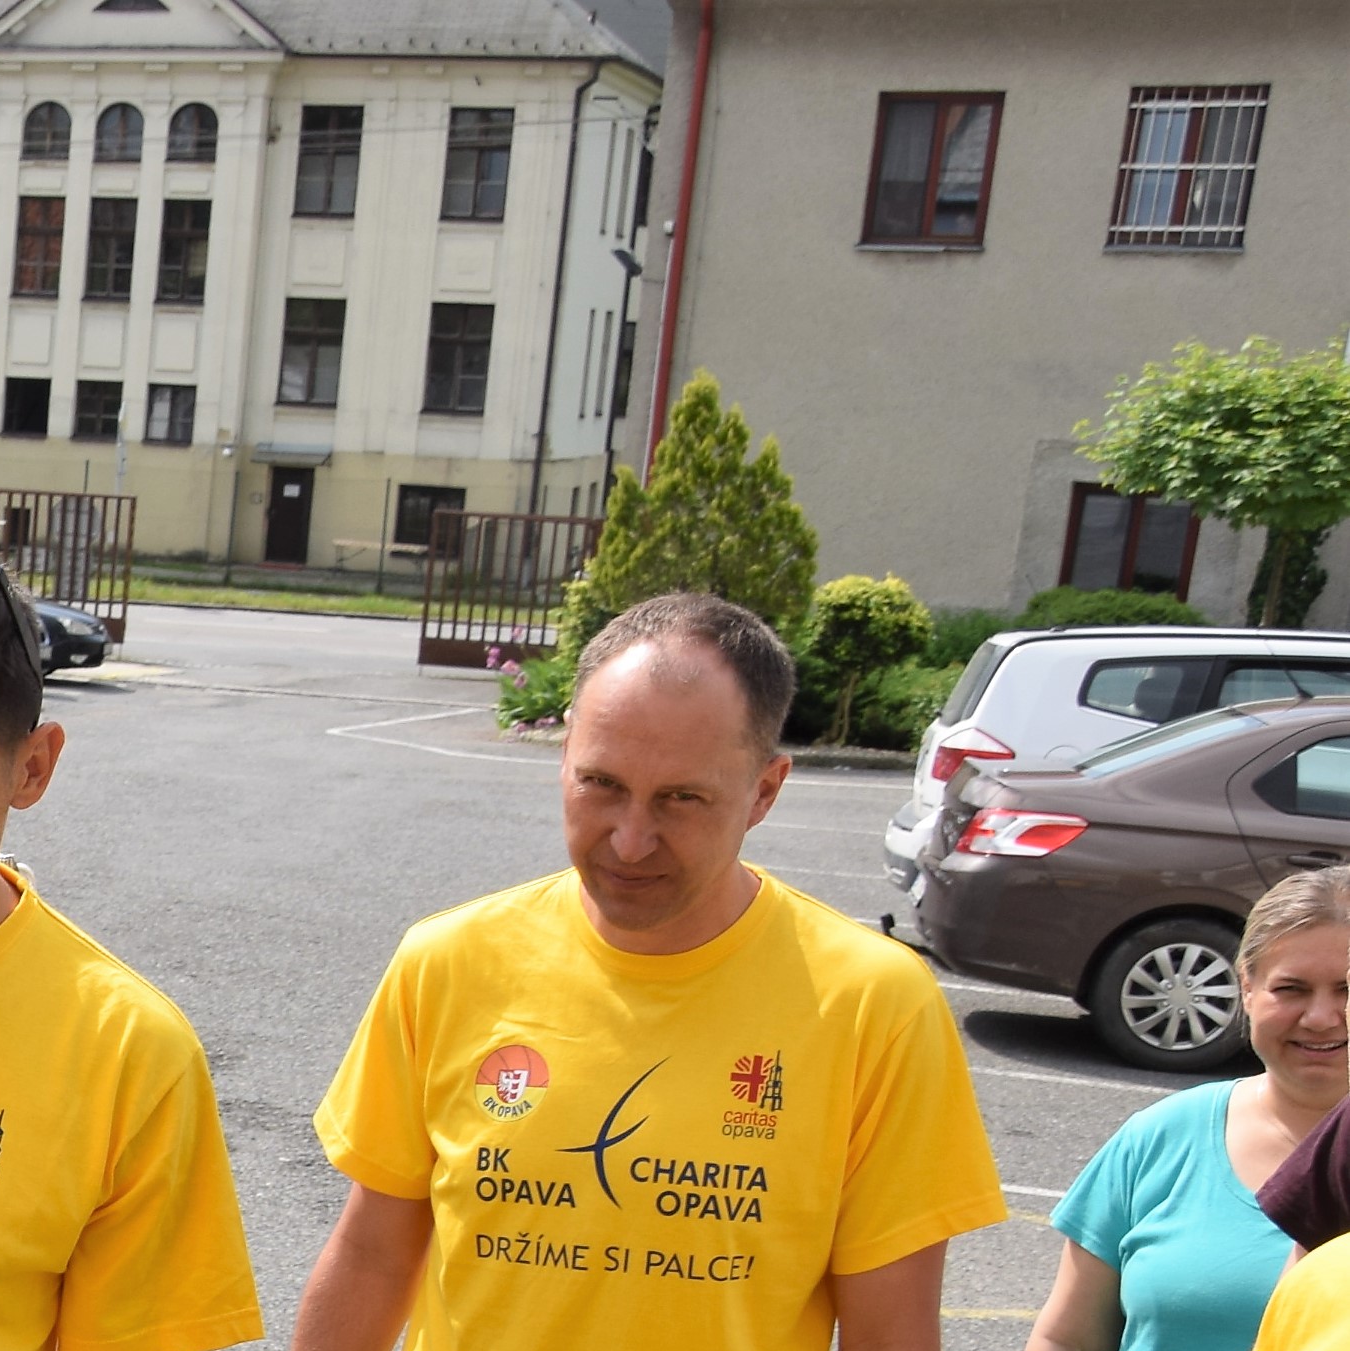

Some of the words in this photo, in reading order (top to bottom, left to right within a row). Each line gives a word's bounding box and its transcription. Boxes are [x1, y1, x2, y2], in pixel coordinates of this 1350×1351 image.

[483, 1097, 498, 1116] BK
[498, 1099, 533, 1118] OPAVA
[723, 1108, 777, 1128] caritas
[722, 1124, 776, 1141] opava
[477, 1147, 511, 1173] BK
[630, 1156, 768, 1192] CHARITA
[476, 1177, 576, 1208] OPAVA
[656, 1190, 763, 1223] OPAVA
[475, 1232, 590, 1271] DRŽÍME
[604, 1246, 629, 1273] SI
[645, 1250, 755, 1282] PALCE!
